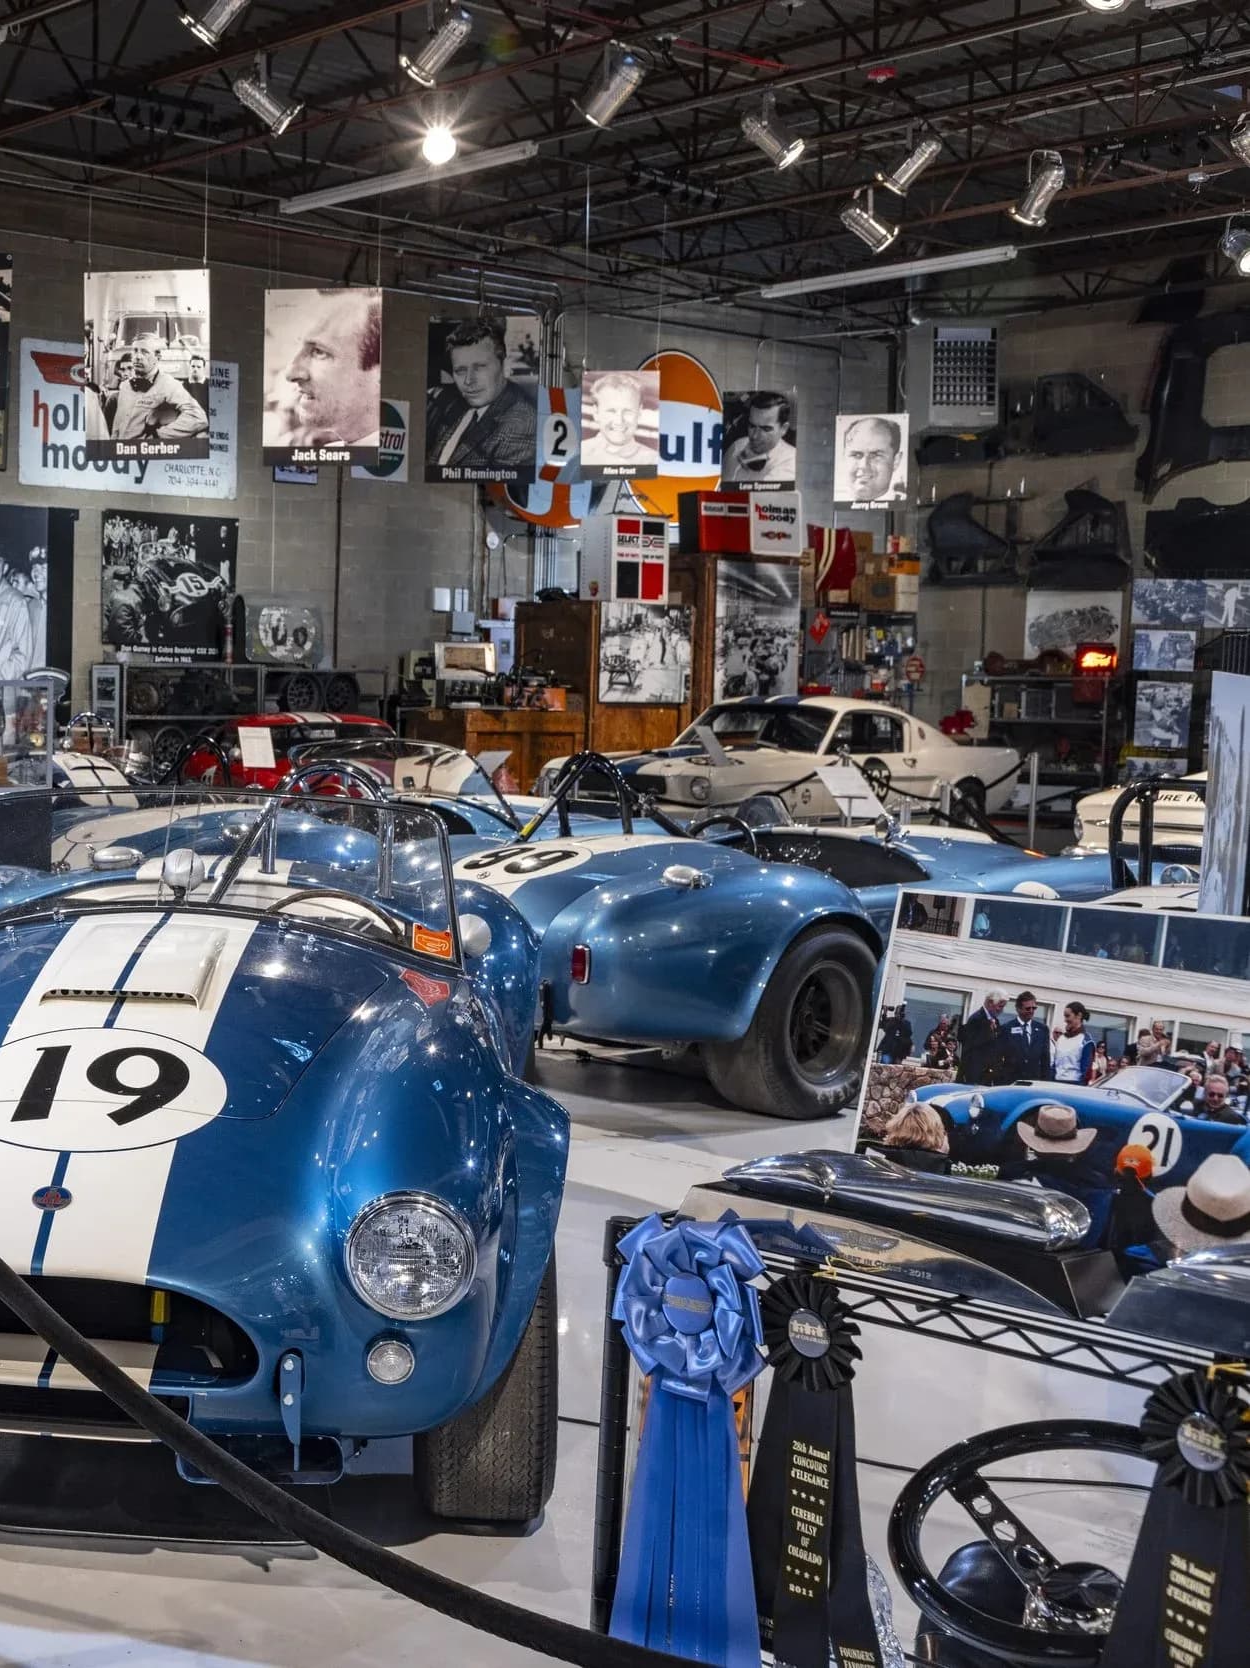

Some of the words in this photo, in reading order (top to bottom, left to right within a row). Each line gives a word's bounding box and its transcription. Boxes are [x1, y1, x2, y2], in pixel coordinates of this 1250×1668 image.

[551, 419, 568, 457] 2
[116, 443, 137, 455] Dan
[139, 442, 180, 455] Gerber
[292, 448, 317, 461] Jack
[319, 448, 350, 461] Sears
[442, 467, 461, 480] Phil
[464, 468, 518, 482] Remington
[755, 503, 796, 515] holman
[759, 512, 796, 525] moody
[180, 575, 206, 593] 15
[10, 1046, 191, 1126] 19
[909, 1269, 933, 1281] 2012
[792, 1440, 807, 1454] 28th
[808, 1443, 831, 1461] Annual
[793, 1454, 828, 1474] CONCOURS
[791, 1467, 830, 1490] d'ELEGANCE
[791, 1505, 825, 1527] CEREBRAL
[796, 1521, 817, 1537] PALSY
[801, 1535, 810, 1548] OF
[788, 1544, 823, 1566] COLORADO
[839, 1646, 876, 1662] FOUNDERS
